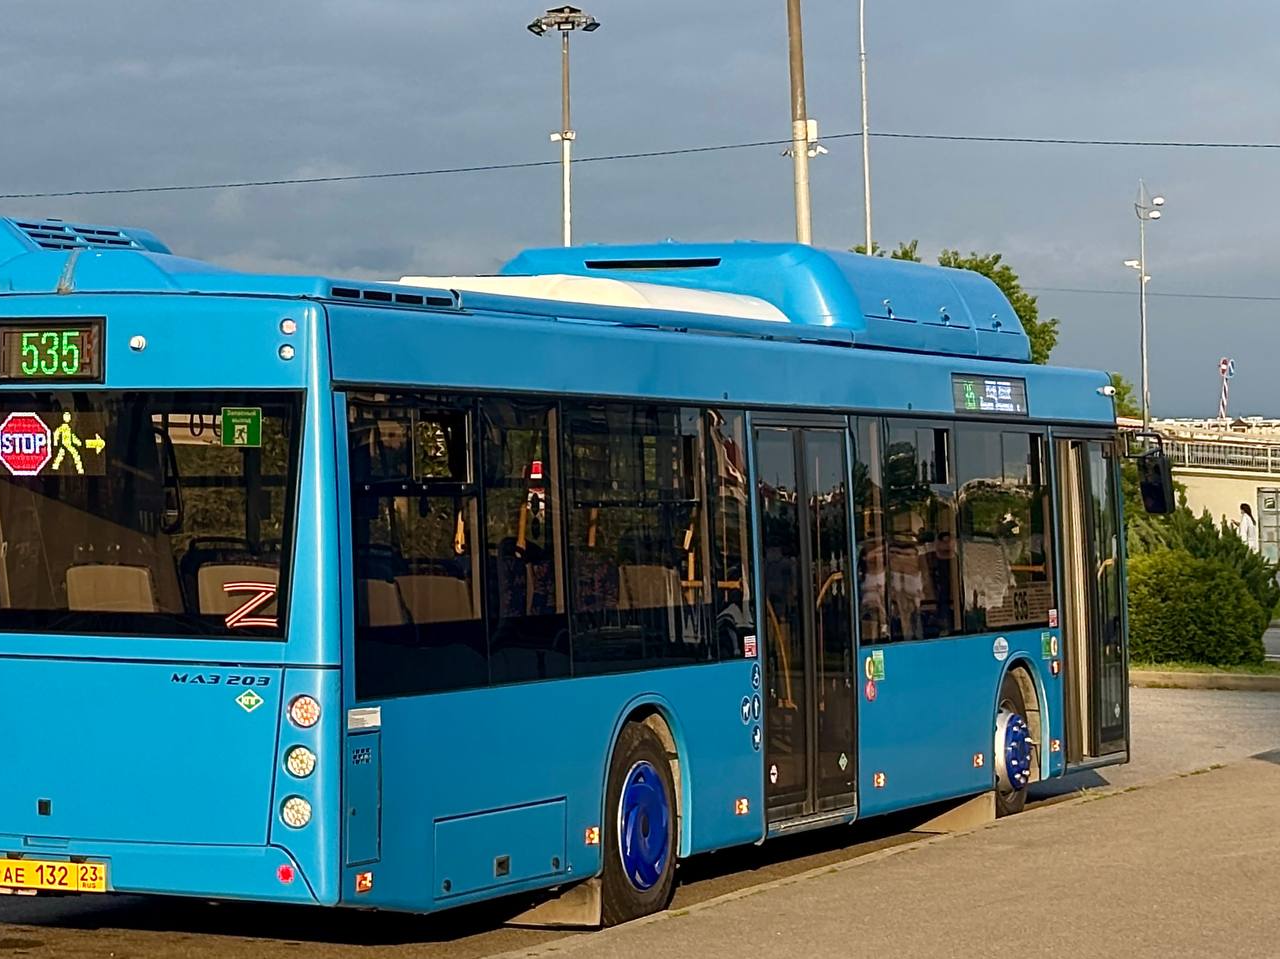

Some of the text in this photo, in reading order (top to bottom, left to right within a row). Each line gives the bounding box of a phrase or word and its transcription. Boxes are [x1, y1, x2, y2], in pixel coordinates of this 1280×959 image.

[22, 331, 79, 375] 535
[1, 433, 46, 455] STOP
[223, 582, 279, 629] Z
[171, 673, 270, 687] МАЗ 203
[35, 864, 68, 887] 132
[80, 866, 98, 882] 23
